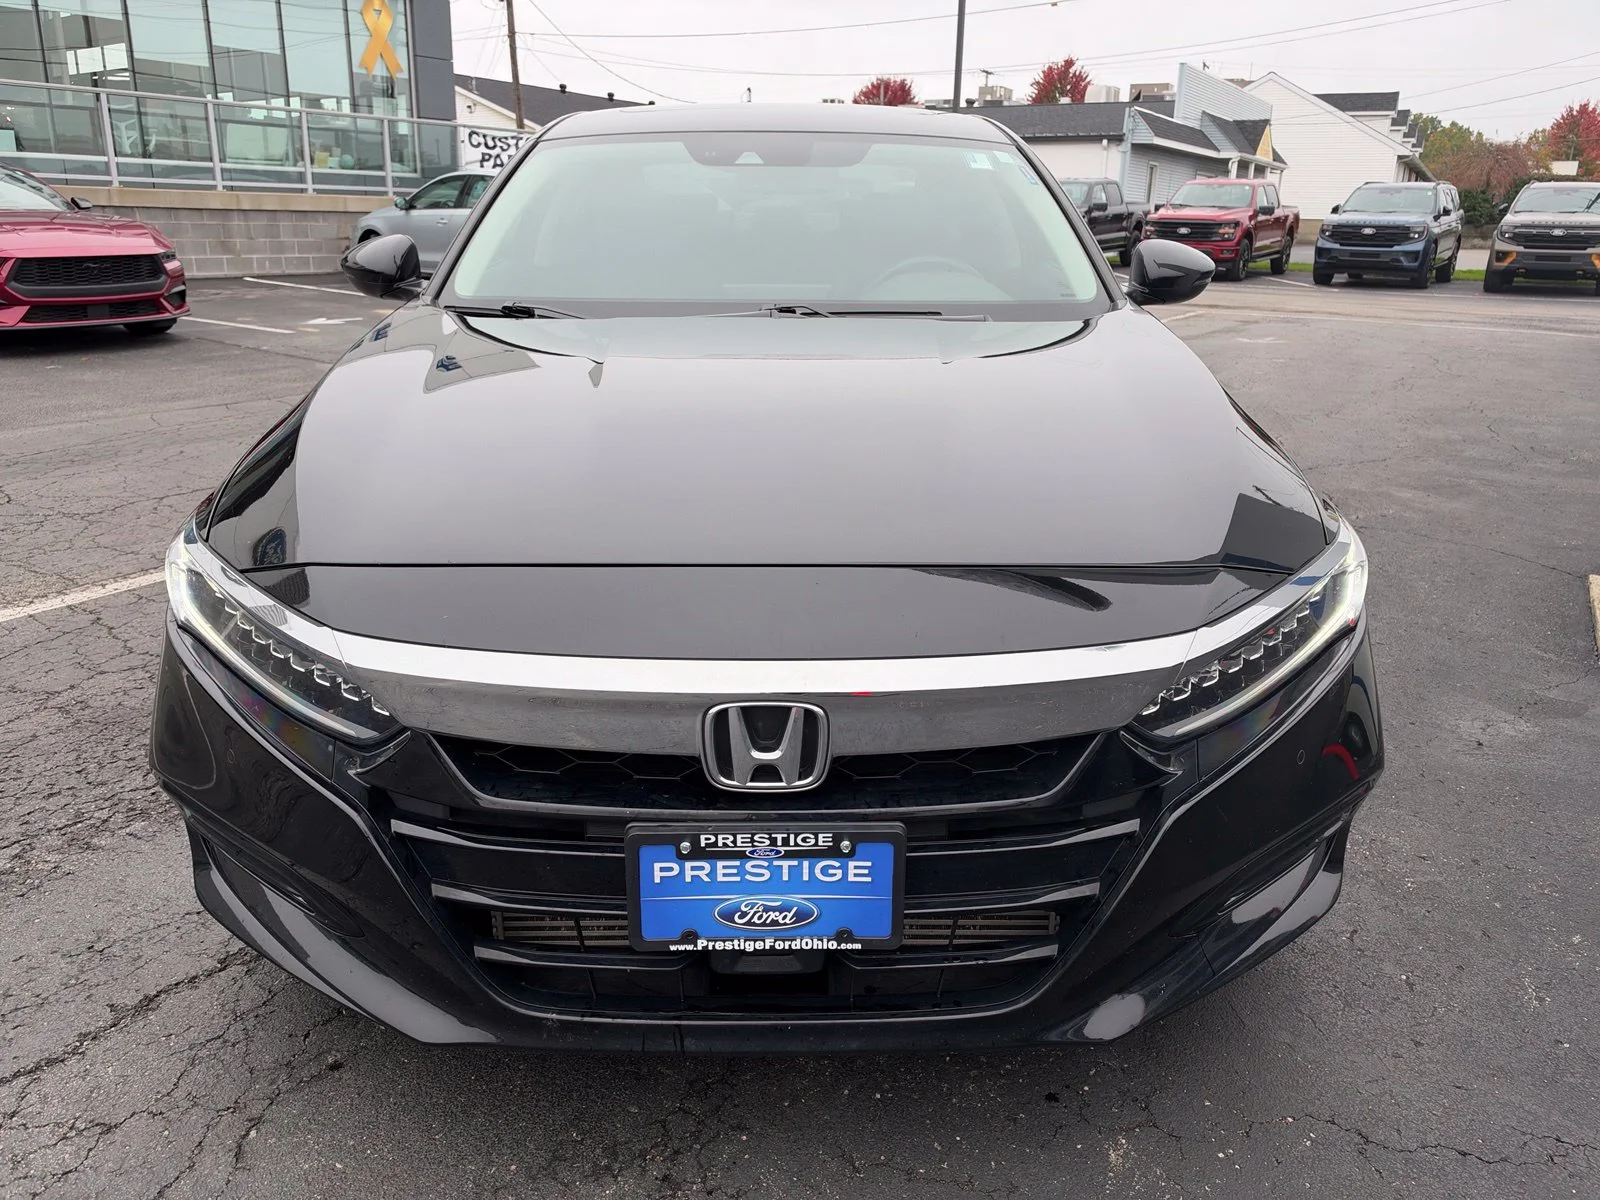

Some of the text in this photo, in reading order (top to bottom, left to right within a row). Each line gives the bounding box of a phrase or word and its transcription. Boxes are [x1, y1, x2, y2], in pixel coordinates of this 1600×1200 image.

[468, 130, 530, 151] CUST
[480, 152, 513, 168] PA
[699, 833, 833, 847] PRESTIGE
[753, 848, 776, 857] Ford
[653, 860, 873, 883] PRESTIGE
[734, 900, 797, 924] Ford
[669, 938, 862, 951] www.PrestigeFordOhio.com
